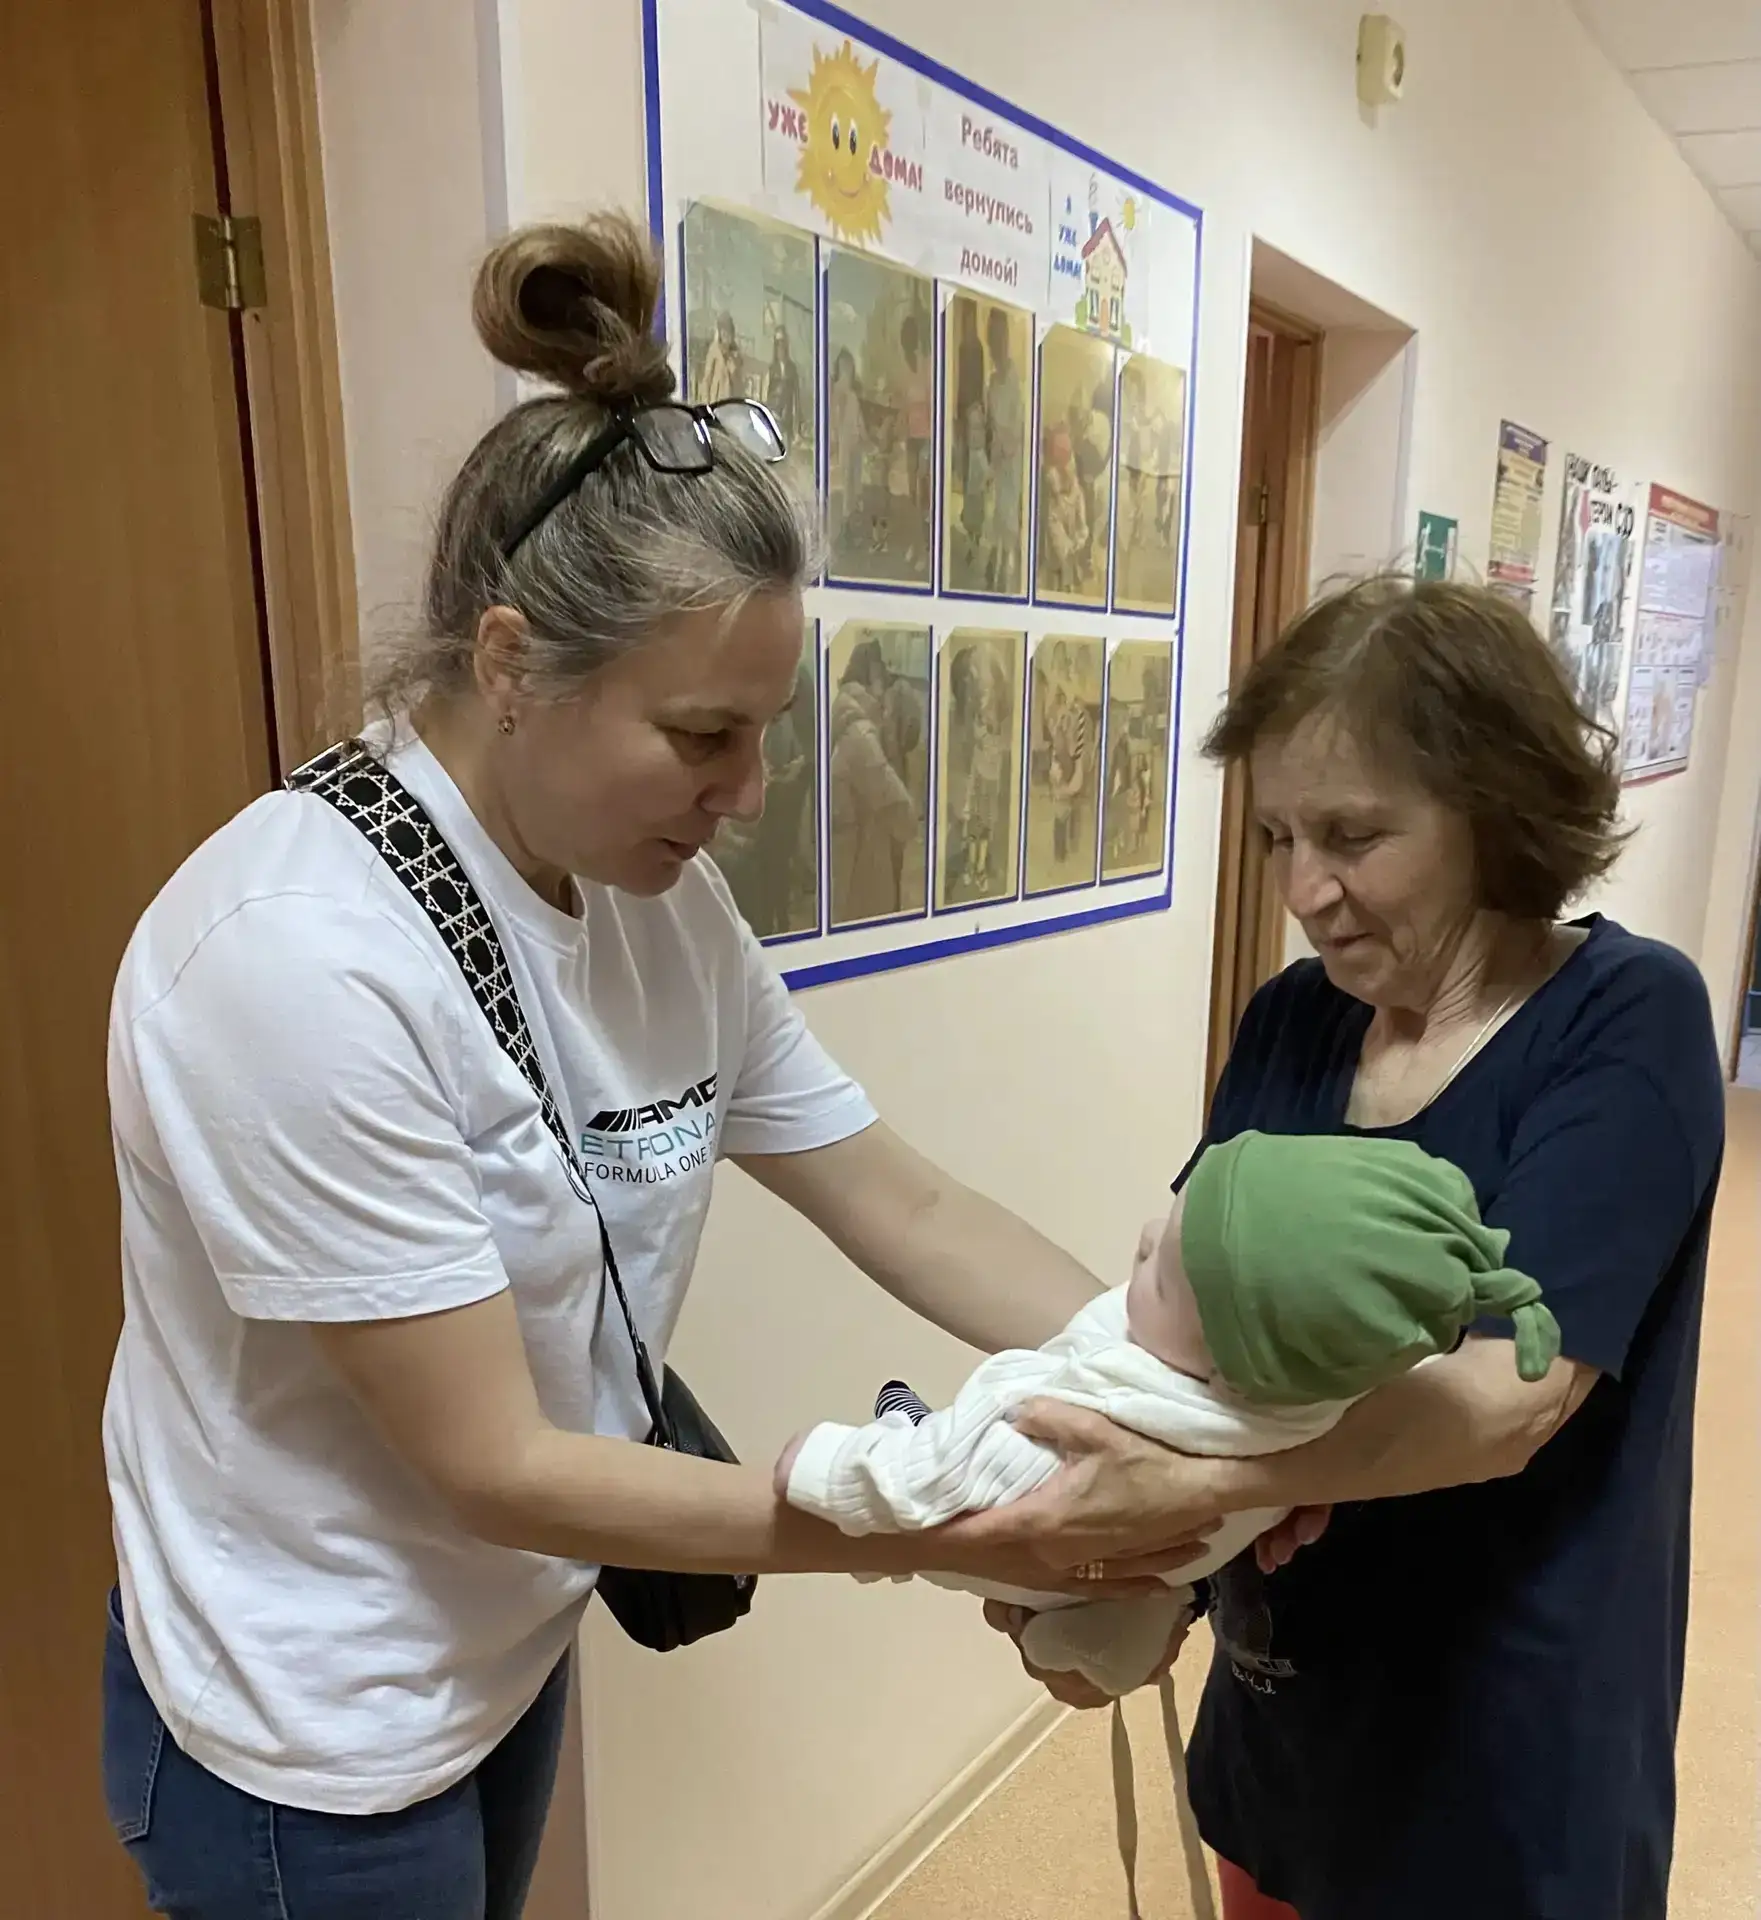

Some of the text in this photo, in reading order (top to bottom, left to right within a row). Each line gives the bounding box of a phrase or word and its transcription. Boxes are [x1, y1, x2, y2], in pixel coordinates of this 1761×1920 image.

[768, 99, 808, 143] УЖЕ
[961, 114, 1019, 169] Ребята
[868, 145, 923, 192] ДОМА!
[960, 247, 1018, 287] домой!
[584, 1162, 677, 1184] FORMULA
[679, 1146, 707, 1173] ONE
